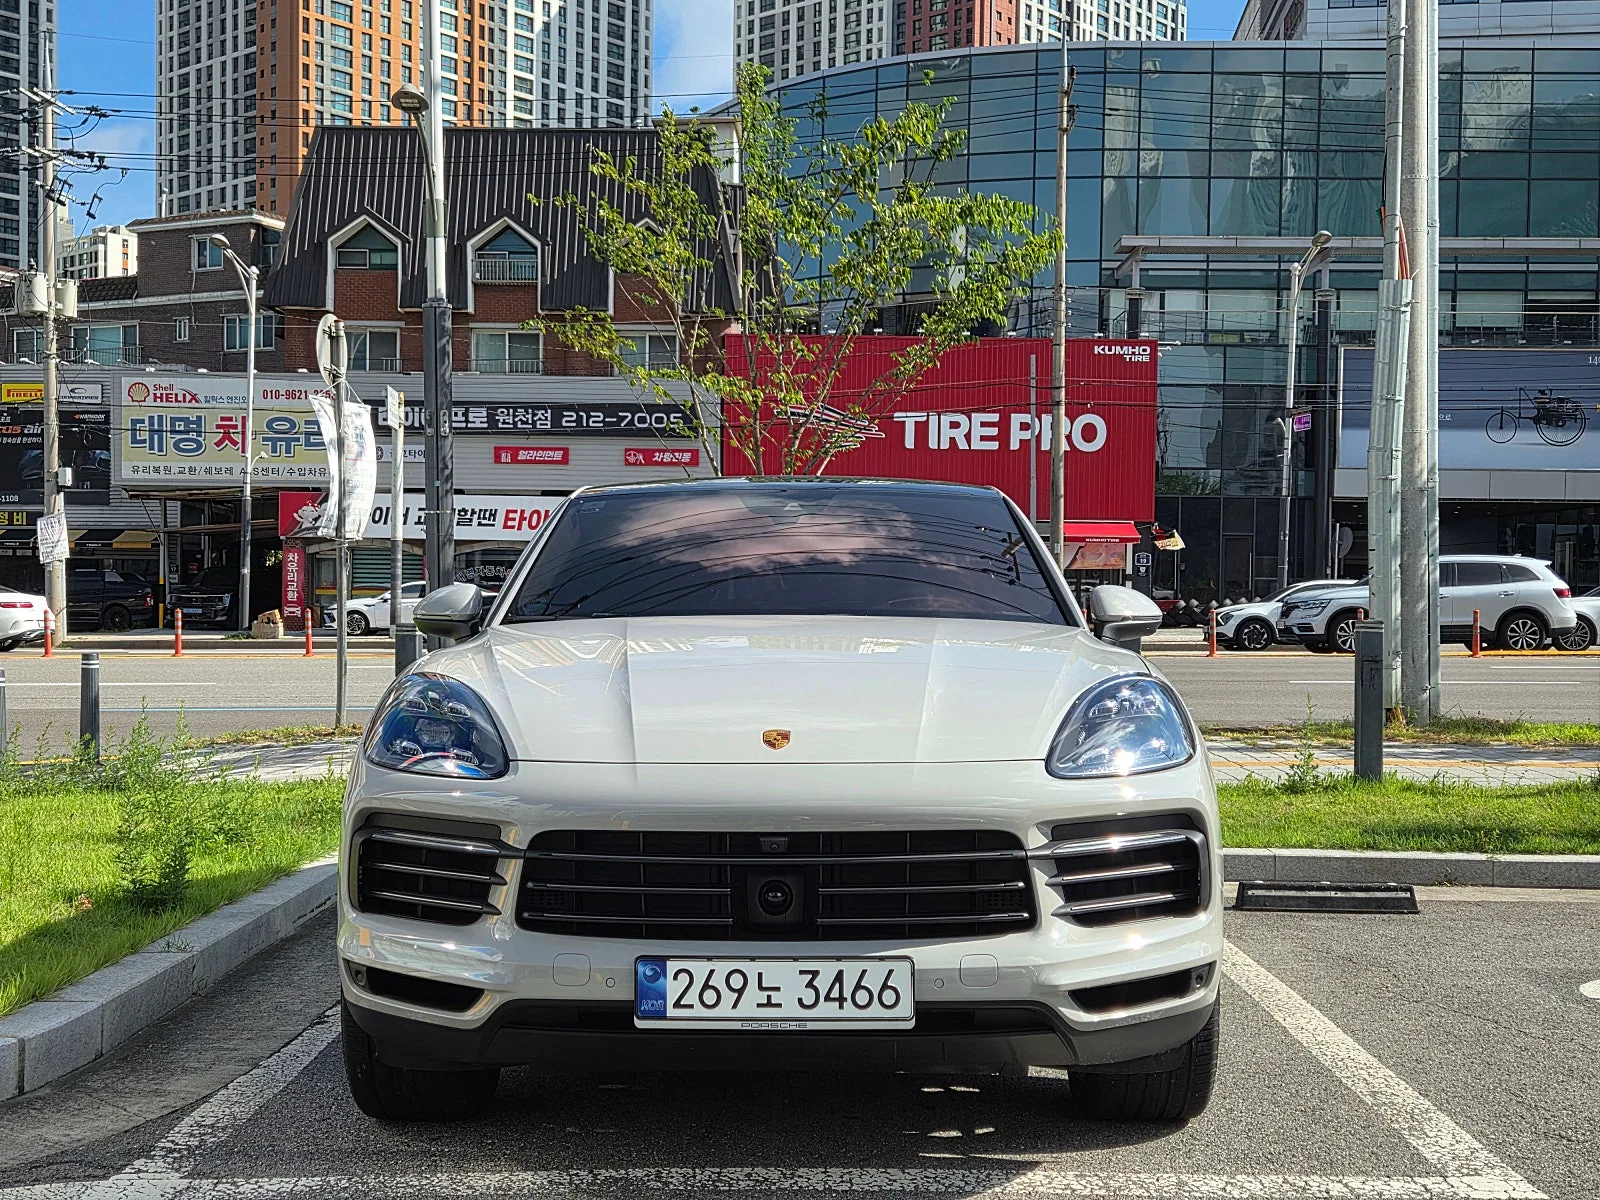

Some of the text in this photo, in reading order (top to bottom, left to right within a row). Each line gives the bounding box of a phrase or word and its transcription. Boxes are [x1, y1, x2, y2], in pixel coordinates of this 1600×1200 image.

[1094, 345, 1151, 355] KUMHO
[153, 383, 174, 391] Shell
[153, 393, 201, 403] HELIX
[226, 395, 254, 404] 엔진오
[495, 408, 551, 429] 원천점
[562, 411, 683, 427] 212-7005
[893, 412, 1107, 452] TIRE PRO
[239, 467, 332, 477] AS센터/수입차유
[287, 552, 299, 601] 차유리교환
[797, 968, 901, 1010] 3466
